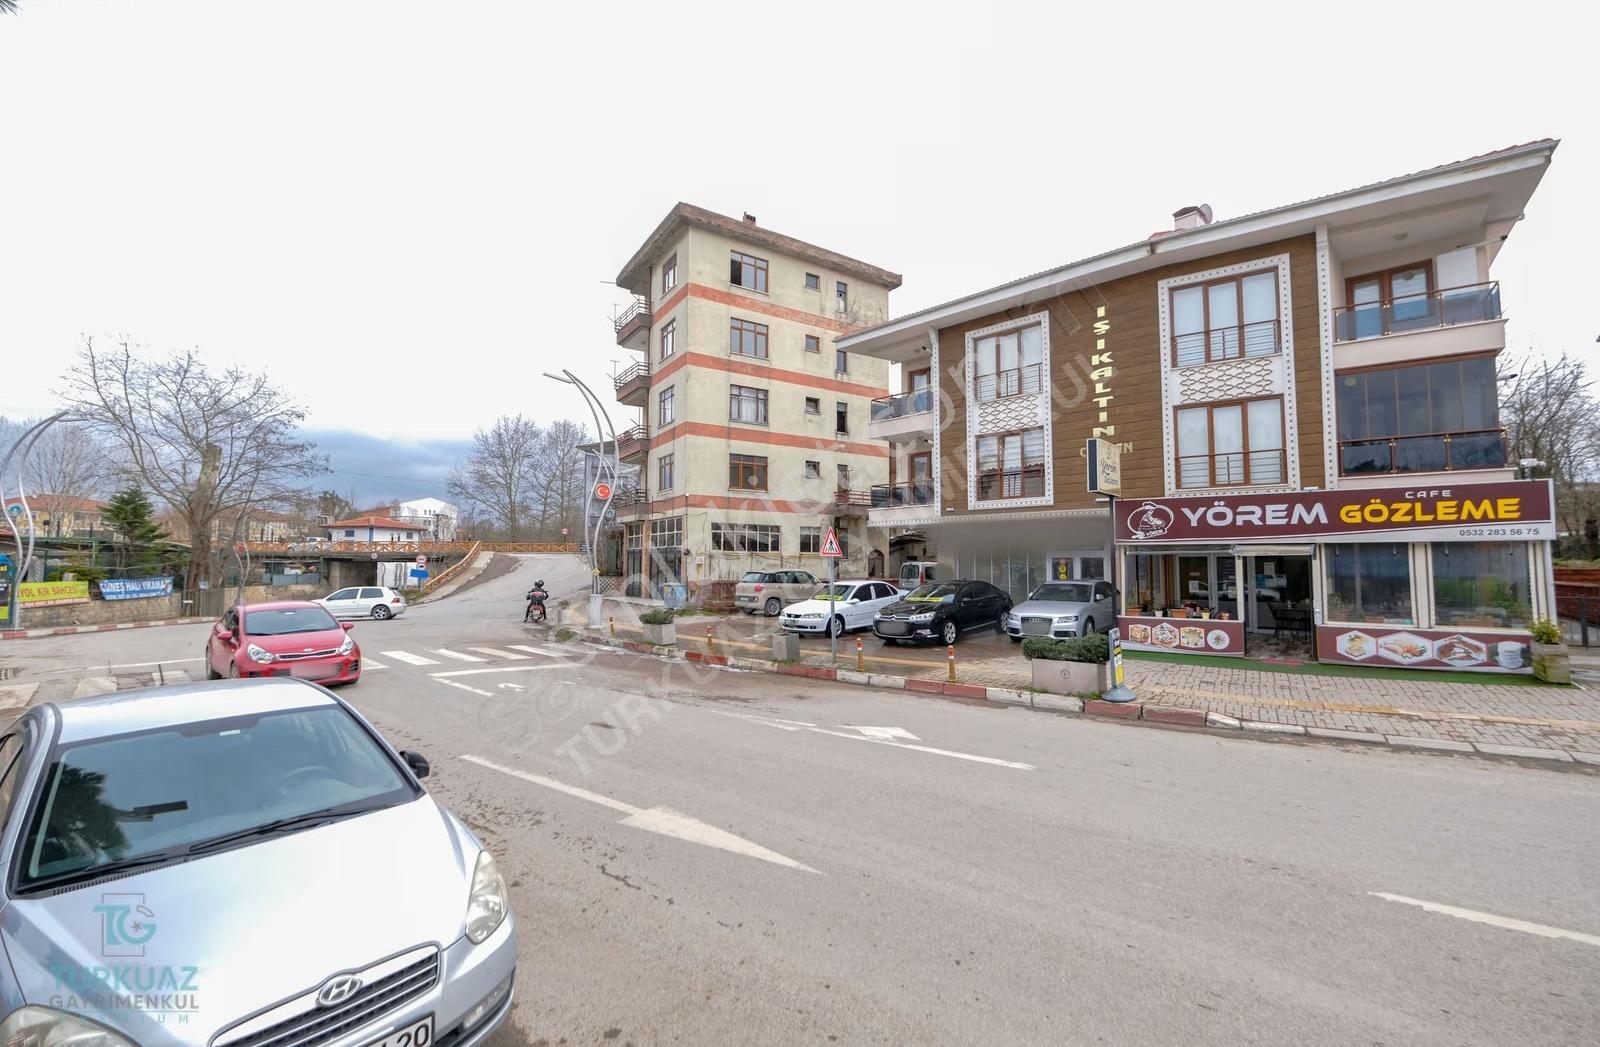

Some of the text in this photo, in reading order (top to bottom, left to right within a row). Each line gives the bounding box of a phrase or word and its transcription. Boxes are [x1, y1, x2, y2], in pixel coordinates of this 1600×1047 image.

[1405, 489, 1451, 499] CAFE
[1180, 498, 1521, 527] YÖREM GÖZLEME
[1459, 528, 1540, 536] 0532 283 56 75
